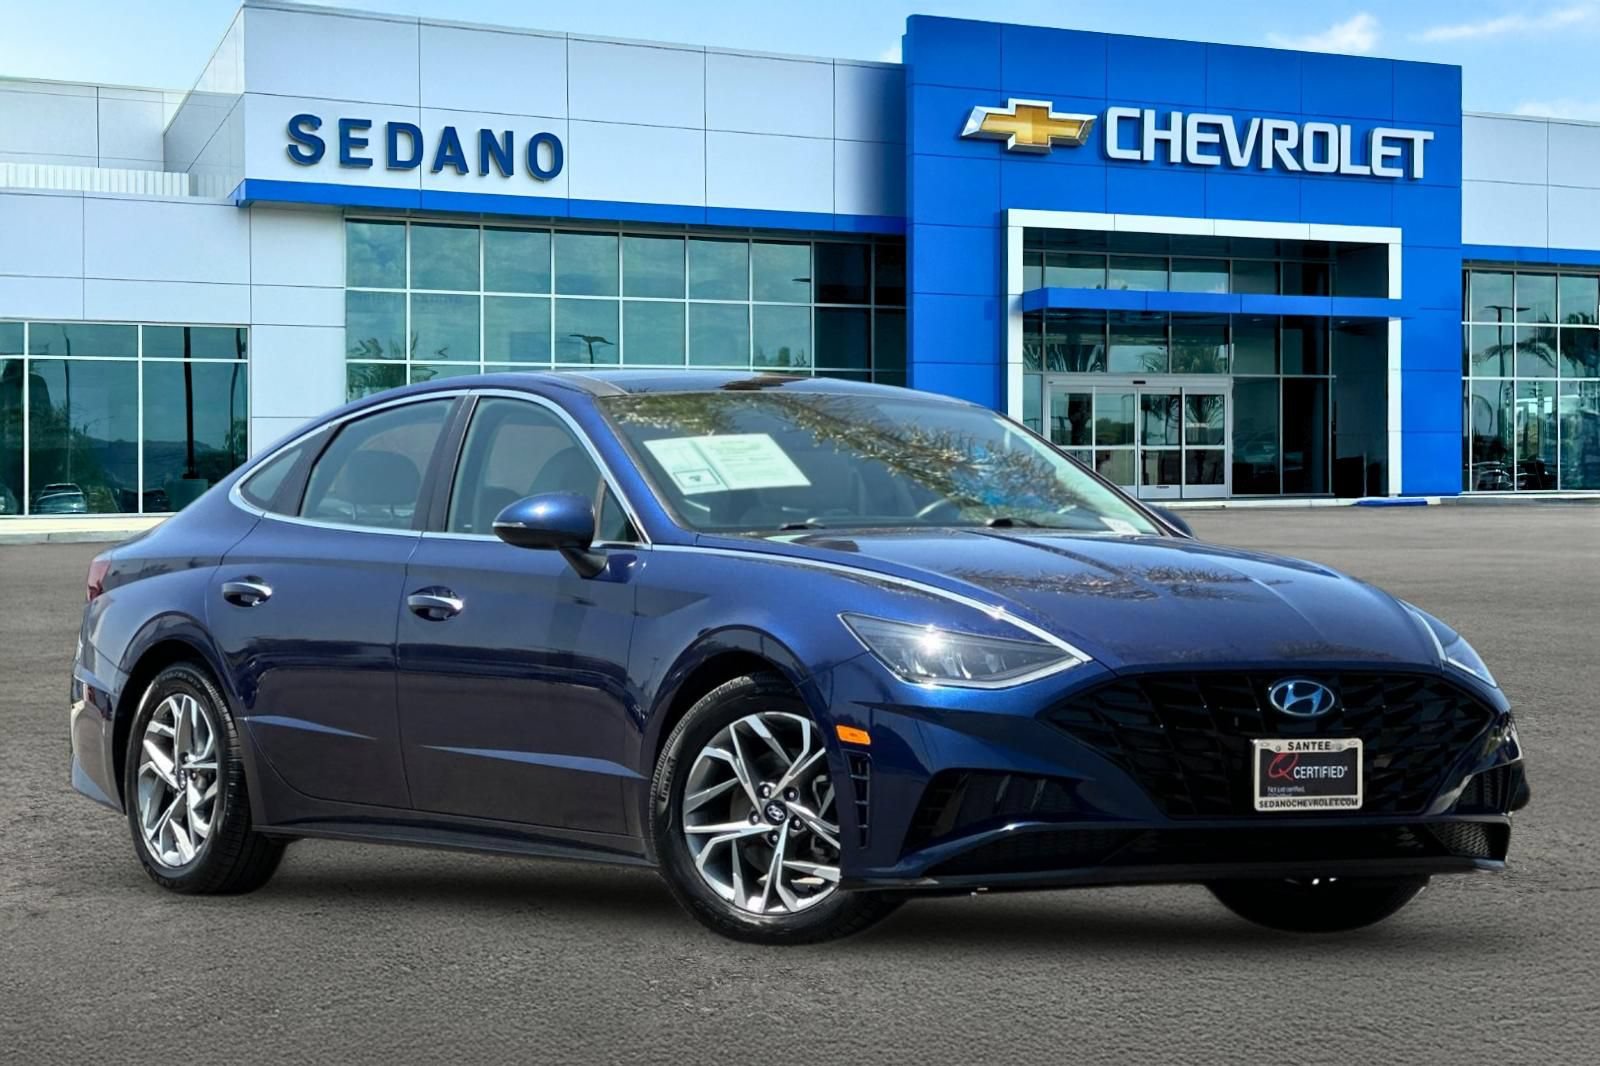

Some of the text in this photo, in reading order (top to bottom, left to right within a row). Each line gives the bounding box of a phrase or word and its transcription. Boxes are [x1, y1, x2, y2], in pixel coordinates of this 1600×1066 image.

[287, 113, 564, 181] SEDANO
[1105, 106, 1435, 179] CHEVROLET
[1288, 741, 1331, 751] SANTEE
[1259, 798, 1358, 808] SEDANOCHEVROLET.COM
